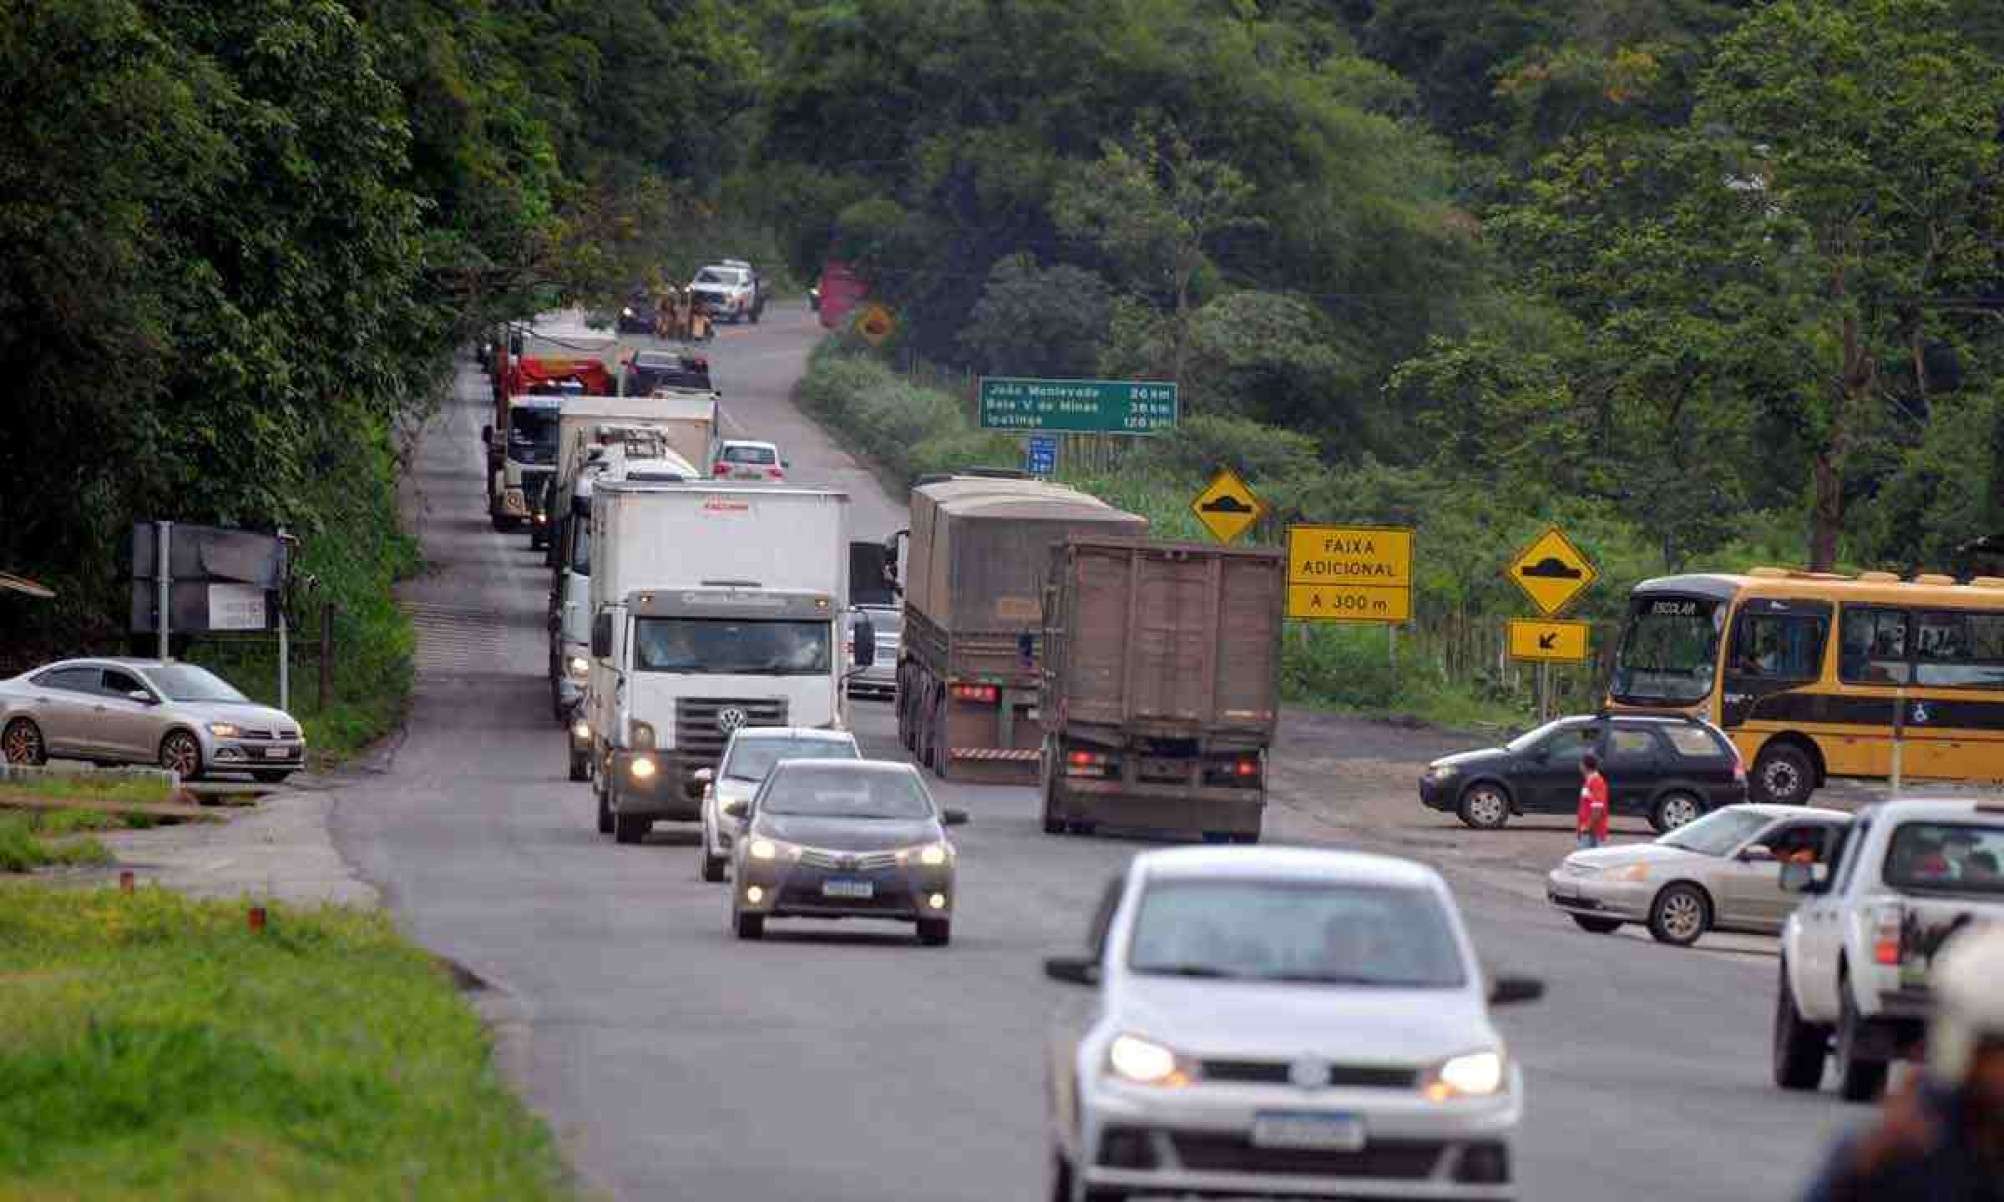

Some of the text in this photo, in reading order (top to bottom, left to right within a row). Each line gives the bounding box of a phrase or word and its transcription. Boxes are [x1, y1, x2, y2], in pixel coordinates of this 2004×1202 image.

[1325, 538, 1376, 554] FAIXA
[1303, 560, 1397, 577] ADICIONAL
[1310, 593, 1389, 610] A 300 m
[1651, 599, 1696, 616] ESCOLAR
